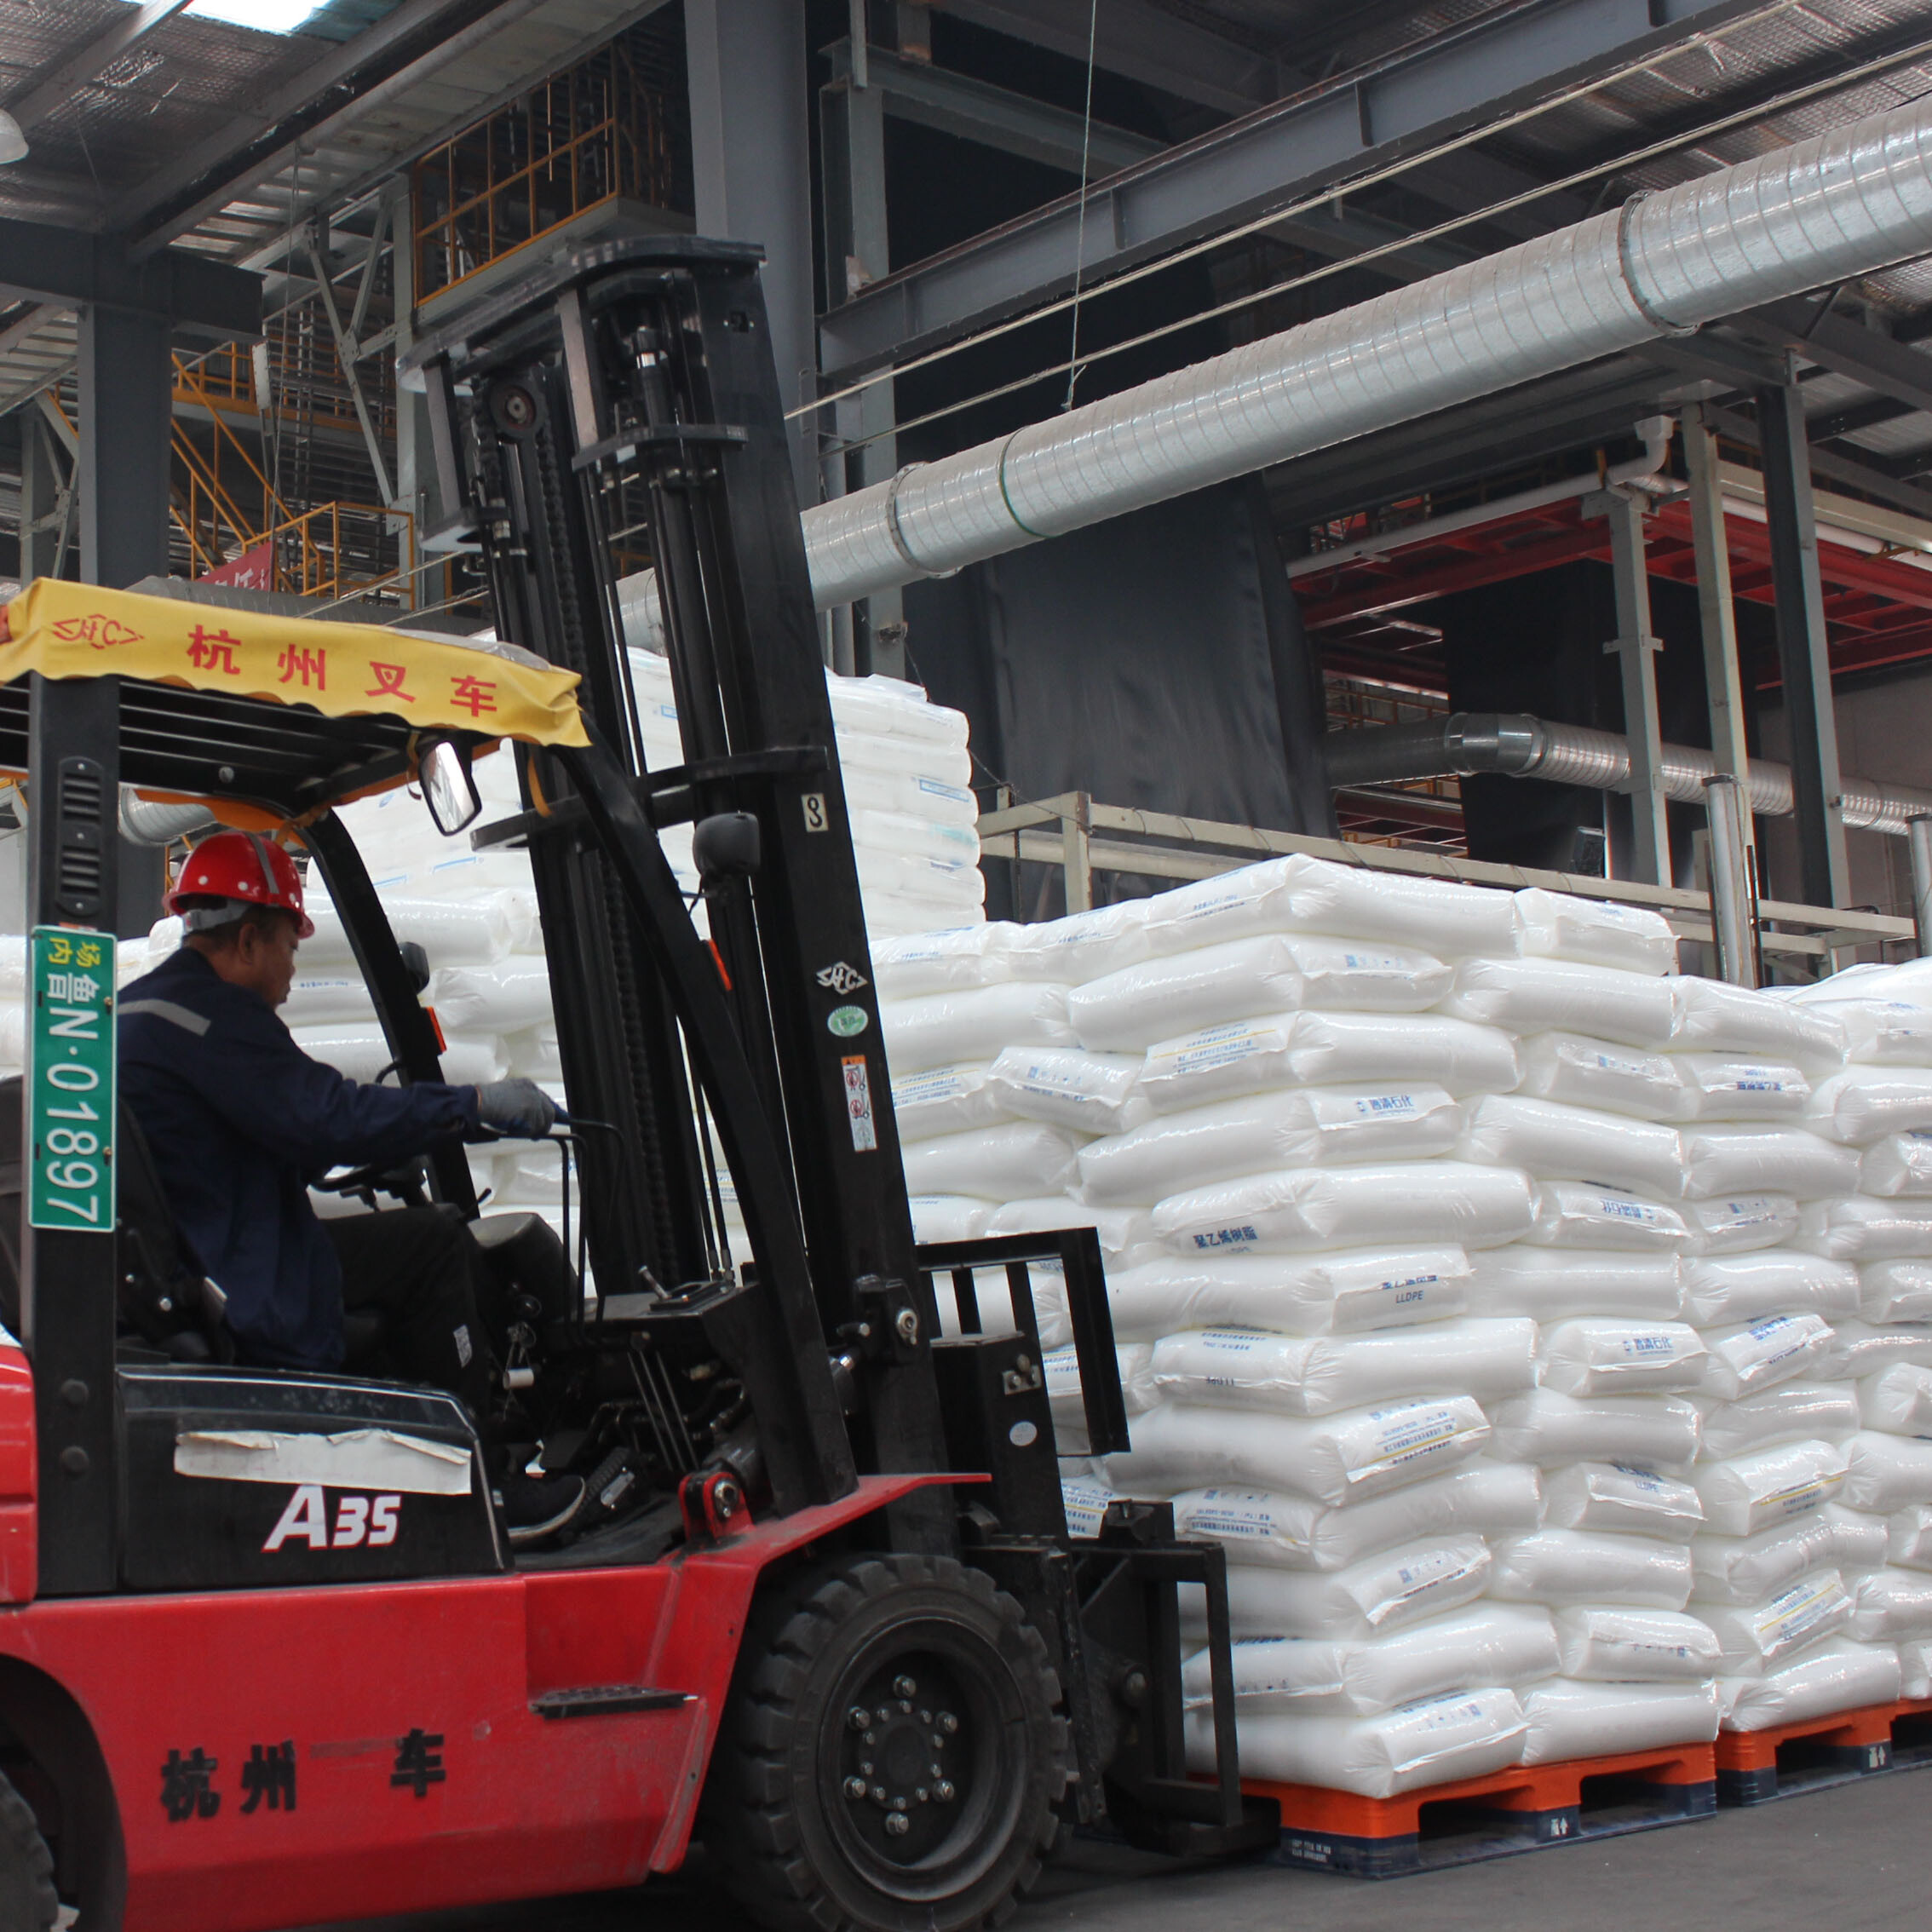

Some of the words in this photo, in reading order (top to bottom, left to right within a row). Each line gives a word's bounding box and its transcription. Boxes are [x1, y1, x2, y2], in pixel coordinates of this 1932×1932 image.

[187, 624, 497, 717] 杭州叉车
[1193, 1225, 1258, 1250] 聚乙烯树脂
[1395, 1290, 1424, 1304] LLDPE
[262, 1485, 401, 1554] A35
